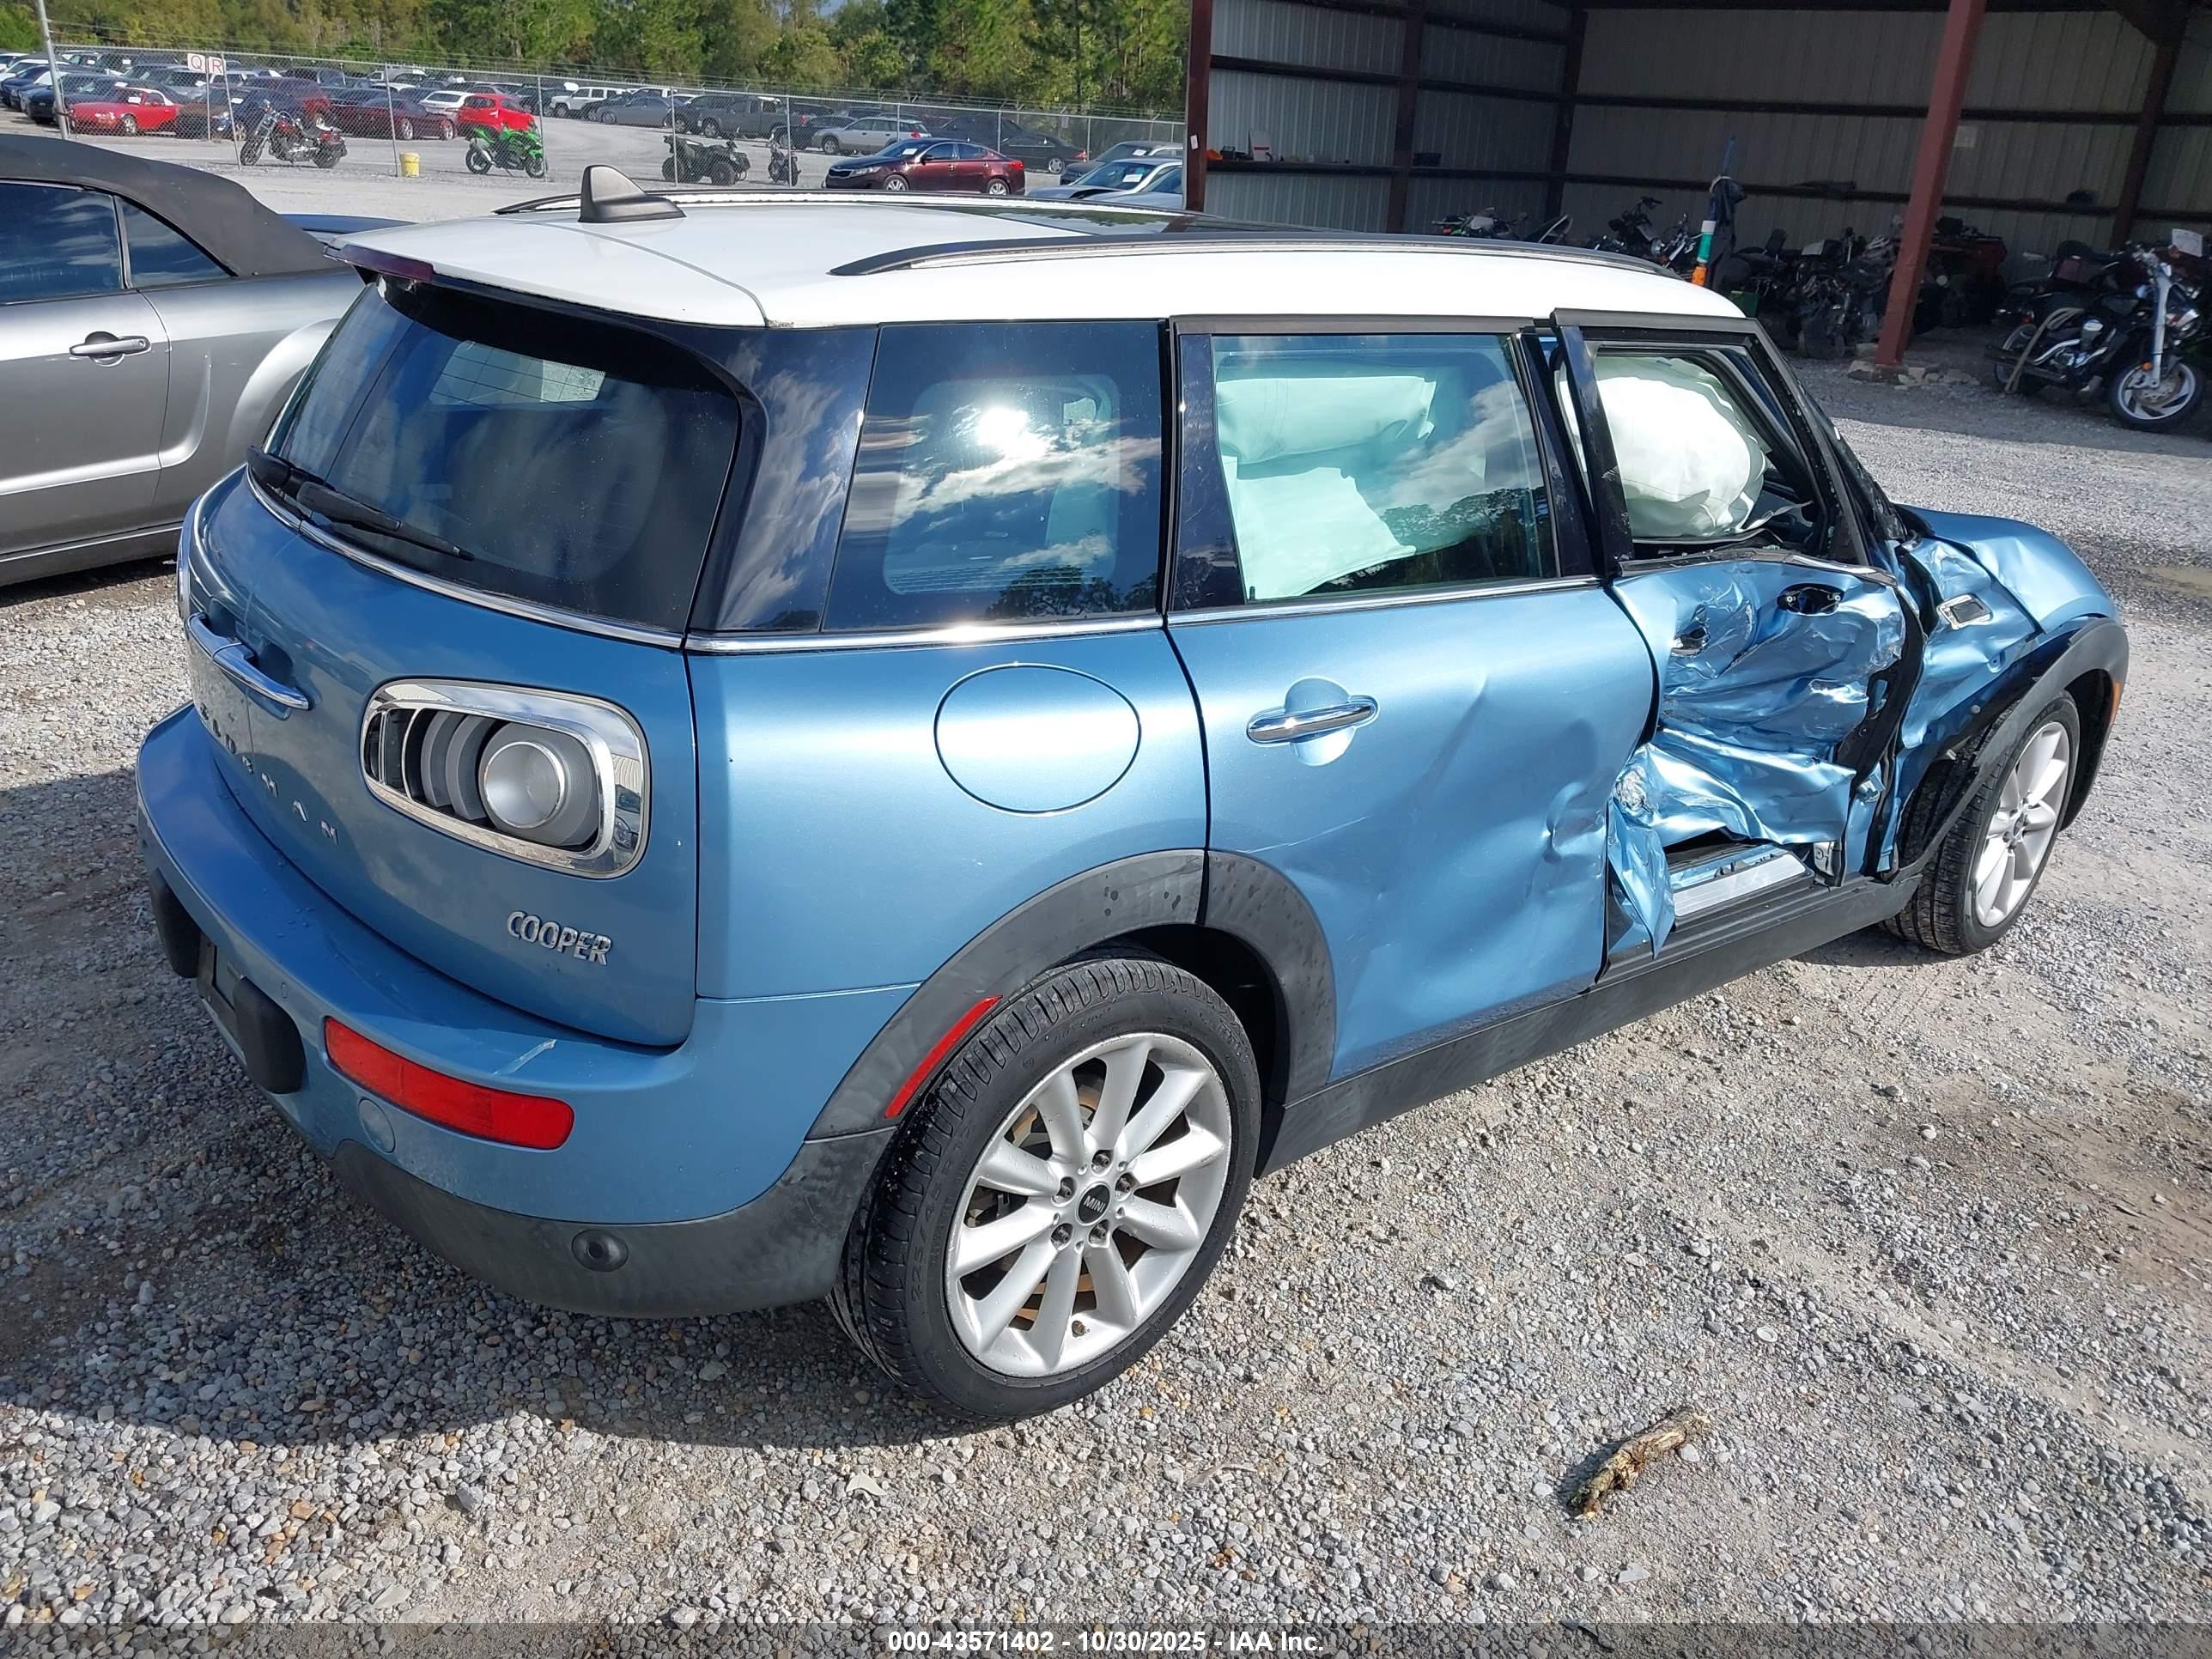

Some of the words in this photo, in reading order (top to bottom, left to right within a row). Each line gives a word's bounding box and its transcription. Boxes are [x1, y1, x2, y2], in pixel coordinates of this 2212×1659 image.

[191, 55, 203, 70] Q
[212, 58, 223, 74] R
[507, 911, 612, 966] COOPER
[1083, 1194, 1107, 1213] MINI
